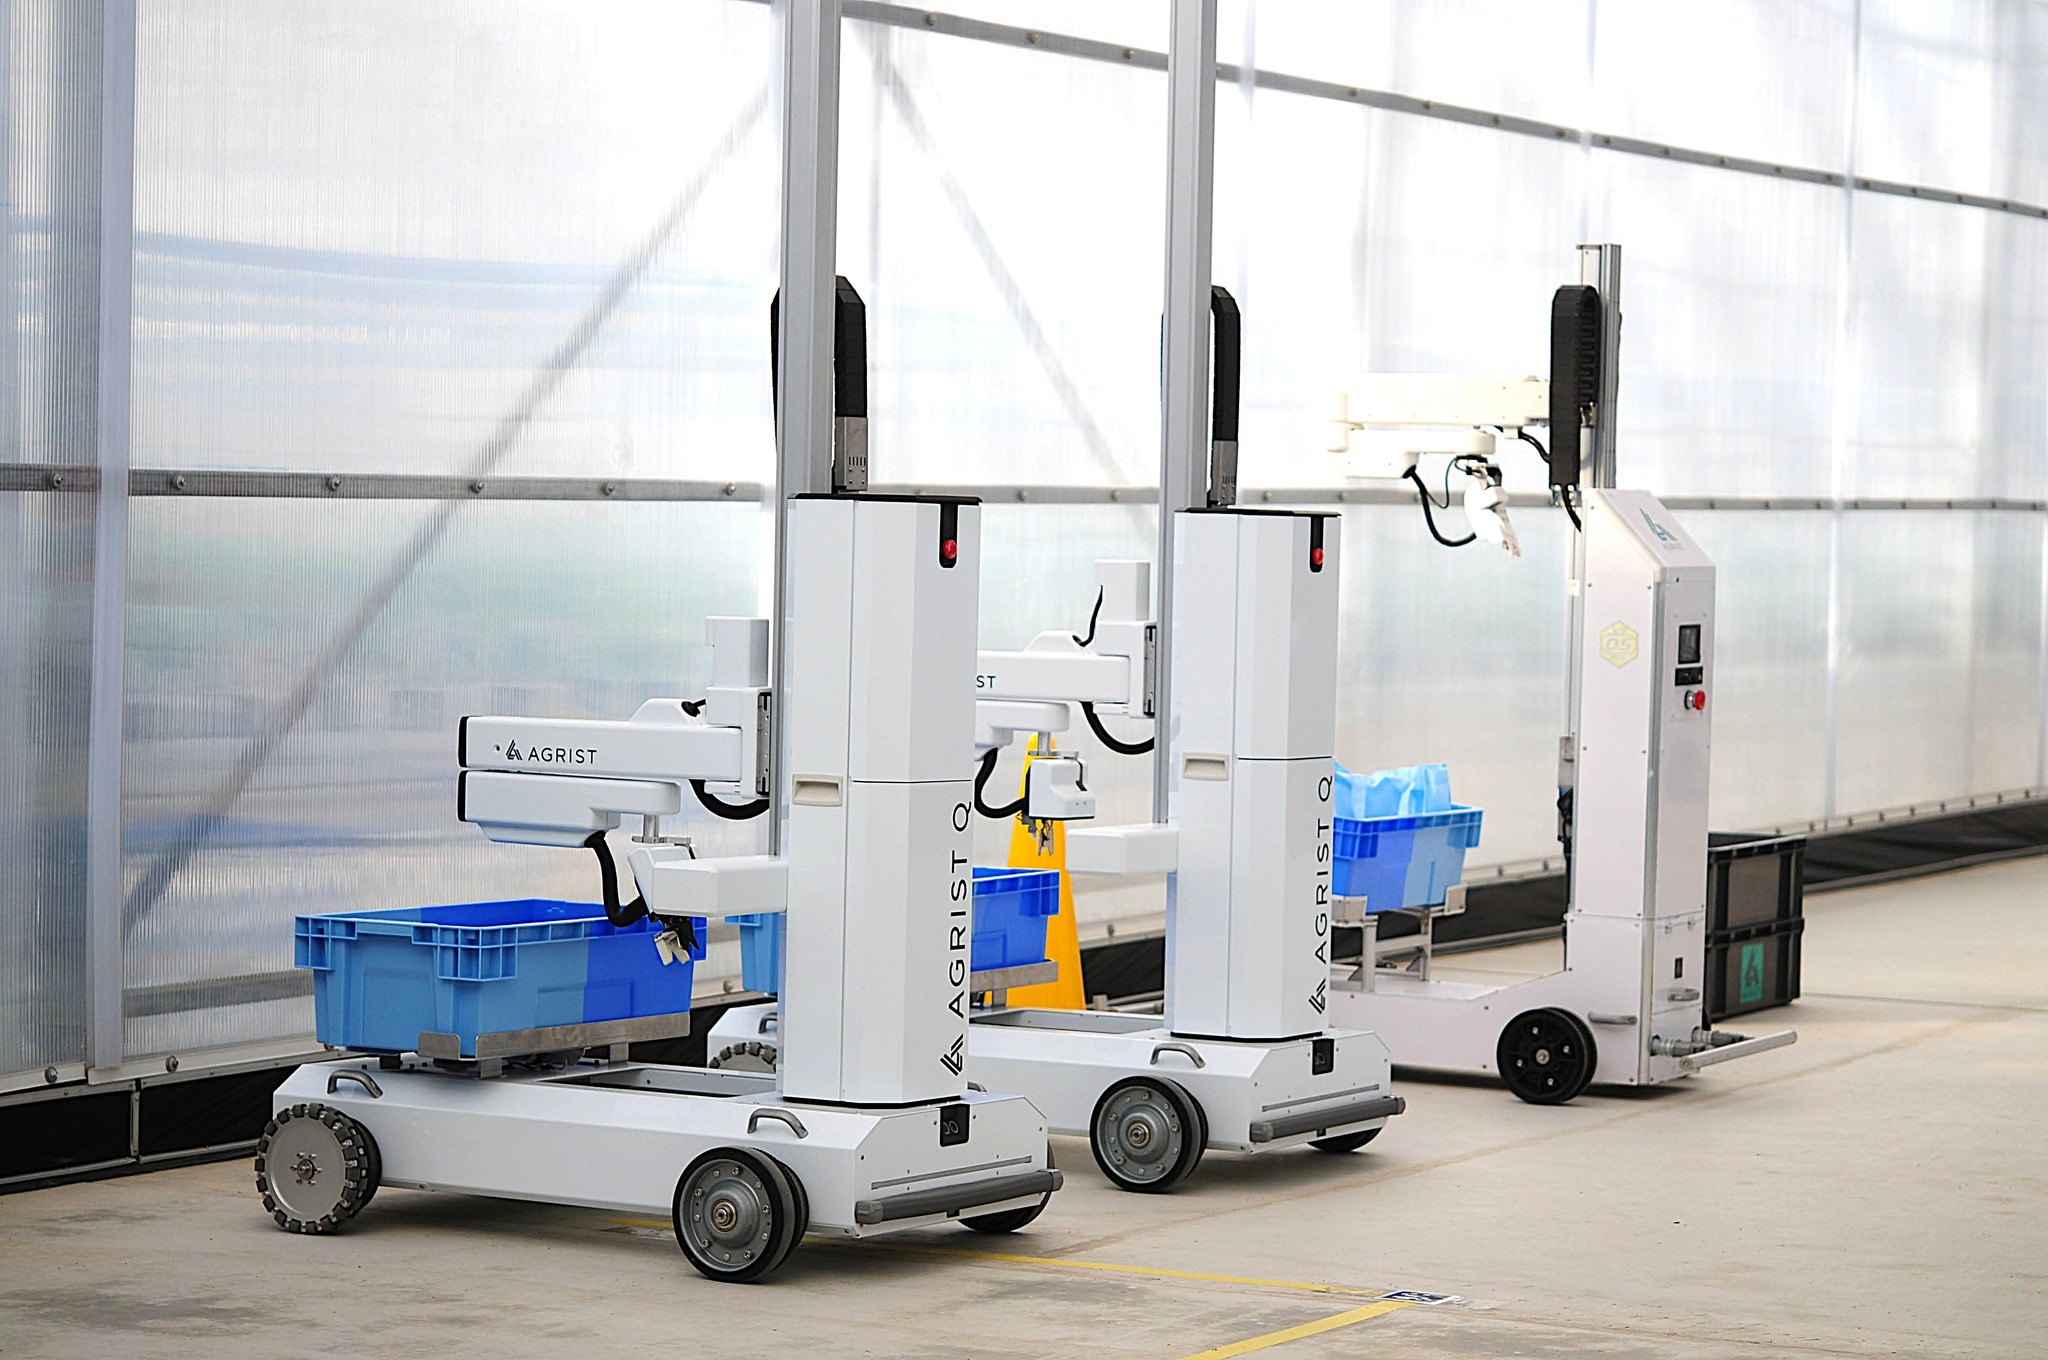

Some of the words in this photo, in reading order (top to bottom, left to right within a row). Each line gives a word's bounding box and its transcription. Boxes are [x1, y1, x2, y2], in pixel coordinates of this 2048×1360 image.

[528, 747, 597, 764] AGRIST
[1318, 776, 1333, 802] Q
[953, 801, 972, 832] Q
[1315, 818, 1330, 964] AGRIST
[948, 850, 968, 1018] AGRIST
